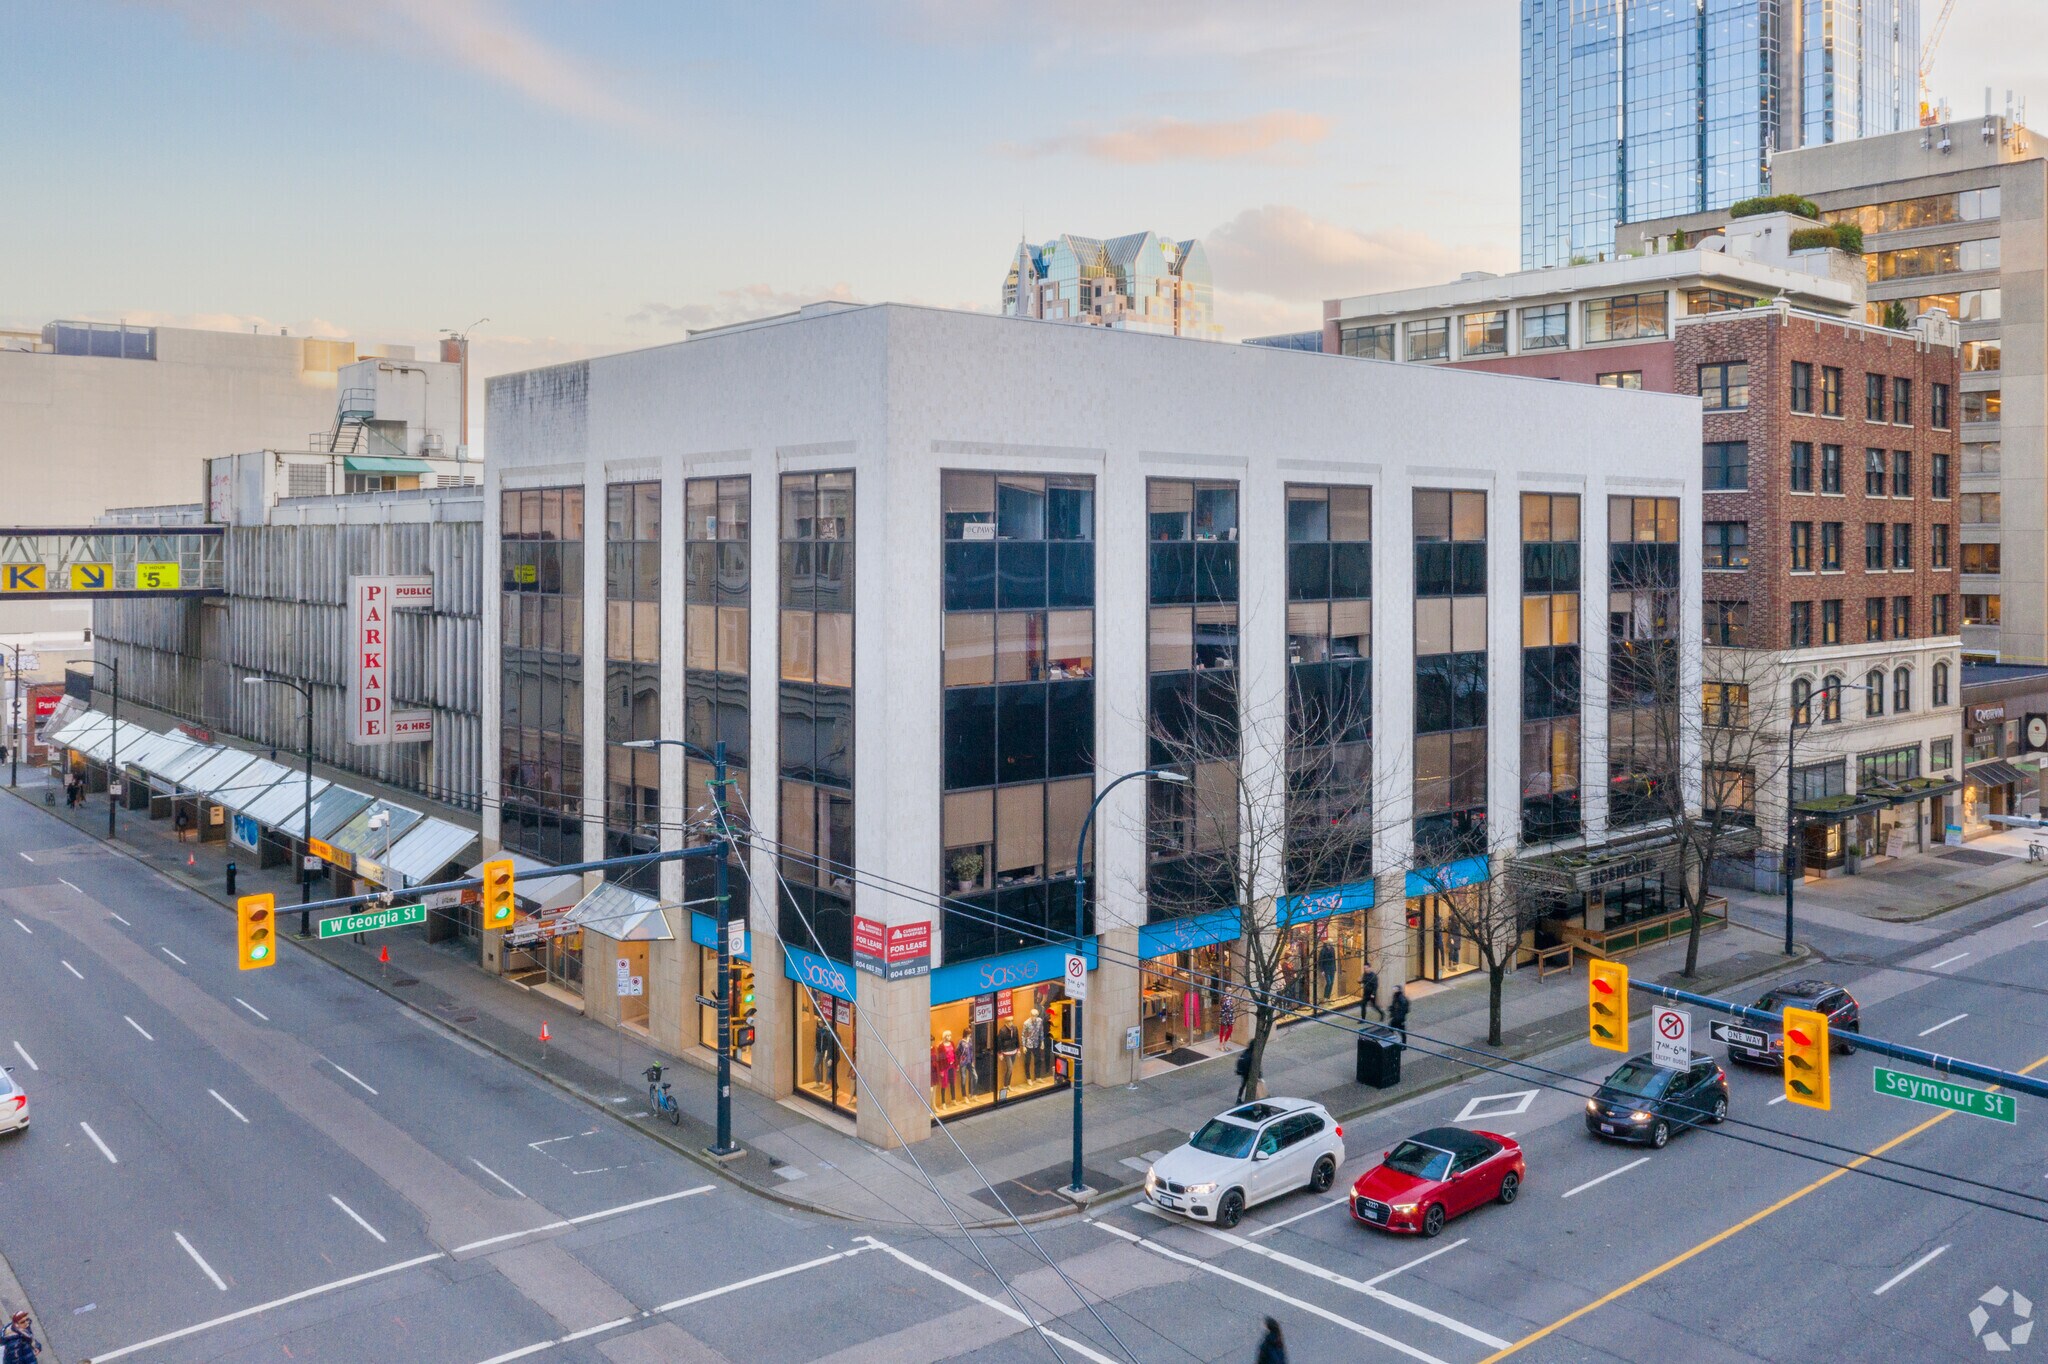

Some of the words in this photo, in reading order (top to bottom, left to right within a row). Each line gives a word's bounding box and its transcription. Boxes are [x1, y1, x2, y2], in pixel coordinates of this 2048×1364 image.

[971, 526, 995, 534] CPAWS
[10, 566, 40, 589] K
[396, 587, 432, 596] PUBLIC
[364, 586, 382, 735] PARKADE
[396, 724, 408, 732] 24
[411, 722, 431, 731] HRS
[330, 919, 343, 933] W
[346, 911, 399, 930] Georgia
[404, 907, 416, 920] St
[856, 936, 867, 944] FOR
[867, 939, 882, 950] LEASE
[890, 945, 904, 953] FOR
[905, 941, 927, 950] LEASE
[855, 960, 865, 968] 604
[904, 967, 916, 975] 683
[916, 965, 929, 973] 3111
[803, 955, 846, 993] Sasso
[980, 960, 1039, 989] Sasso
[997, 998, 1011, 1007] LEASE
[997, 1006, 1012, 1016] SALE
[1727, 1030, 1742, 1041] ONE
[1746, 1034, 1762, 1046] WAY
[1069, 1047, 1079, 1055] WAY
[1655, 1053, 1671, 1063] EXCEPT
[1672, 1057, 1687, 1066] BUSES
[1886, 1072, 1975, 1107] Seymour
[1984, 1094, 2004, 1114] St
